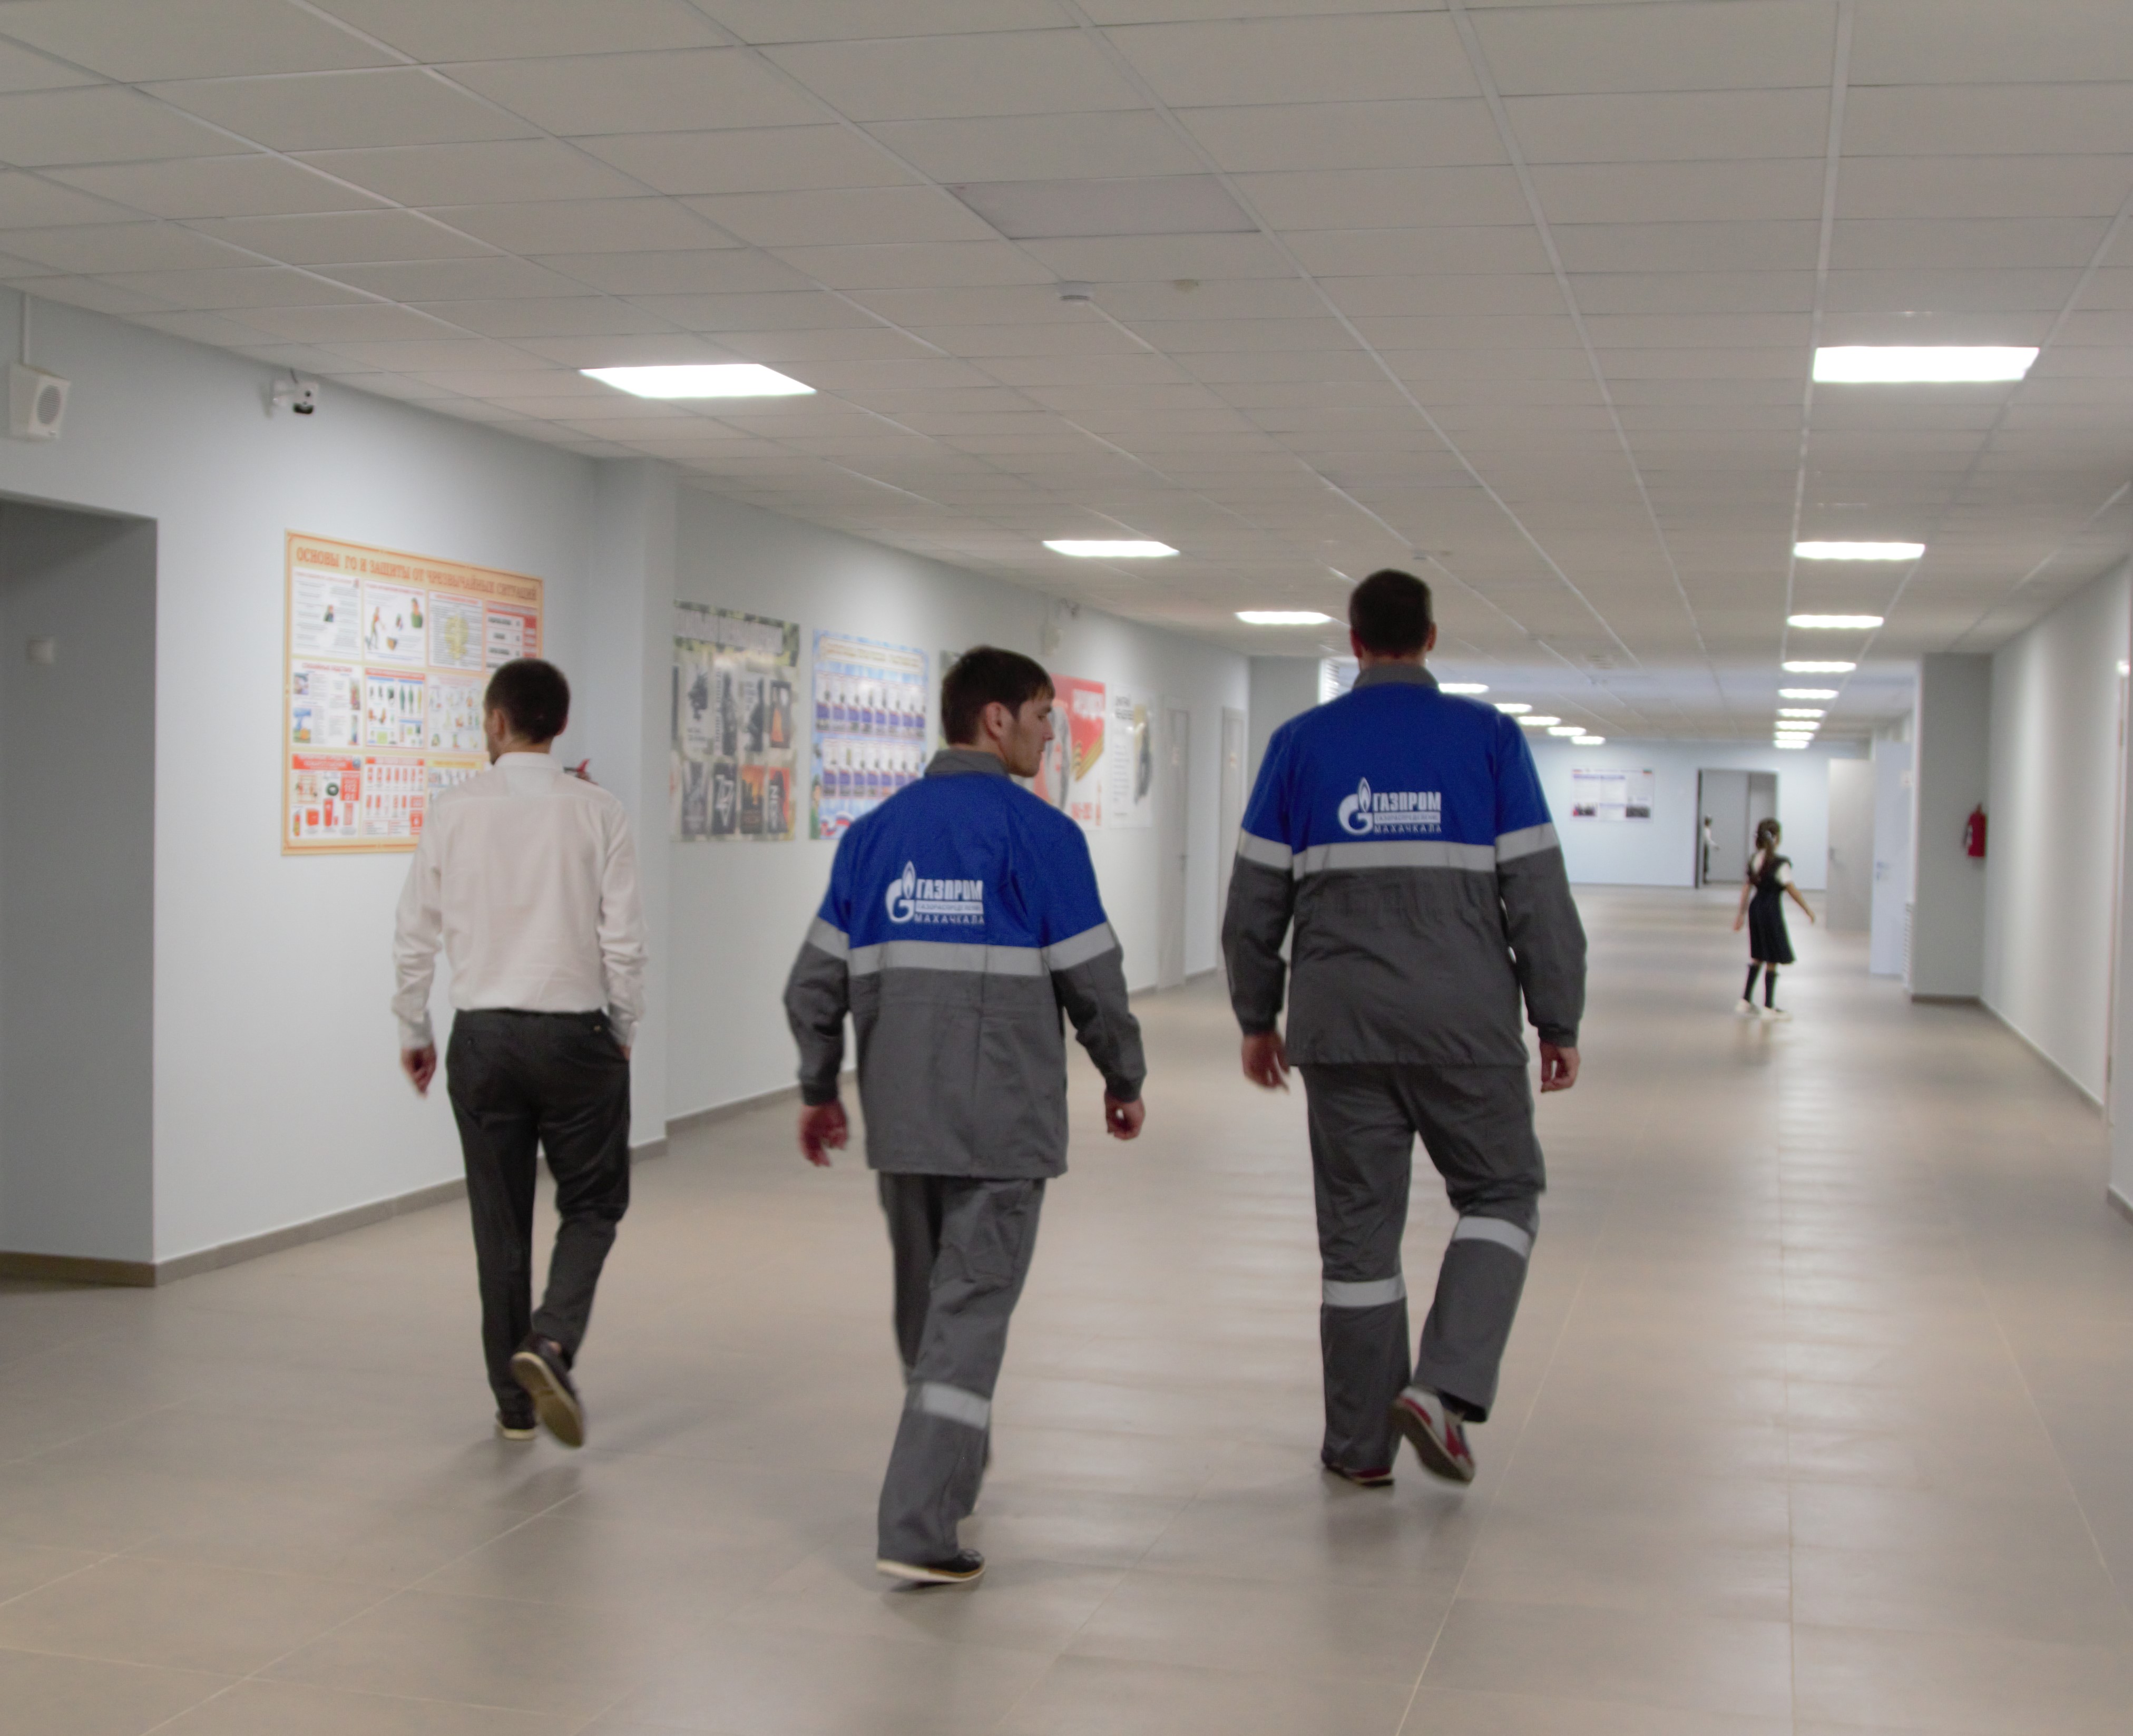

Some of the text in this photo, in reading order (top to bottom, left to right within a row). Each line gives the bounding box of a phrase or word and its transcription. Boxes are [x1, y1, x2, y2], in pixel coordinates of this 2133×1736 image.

[297, 547, 339, 567] ОСНОВЫ
[345, 555, 357, 570] ГО
[360, 558, 367, 572] И
[370, 560, 410, 579] ЗАЩИТЫ
[413, 568, 424, 581] ОТ
[1373, 792, 1441, 811] ГАЗПРОМ
[1373, 824, 1442, 833] МАХАЧКАЛА
[916, 879, 983, 901] ГАЗПРОМ
[914, 913, 985, 924] МАХАЧКАЛА
